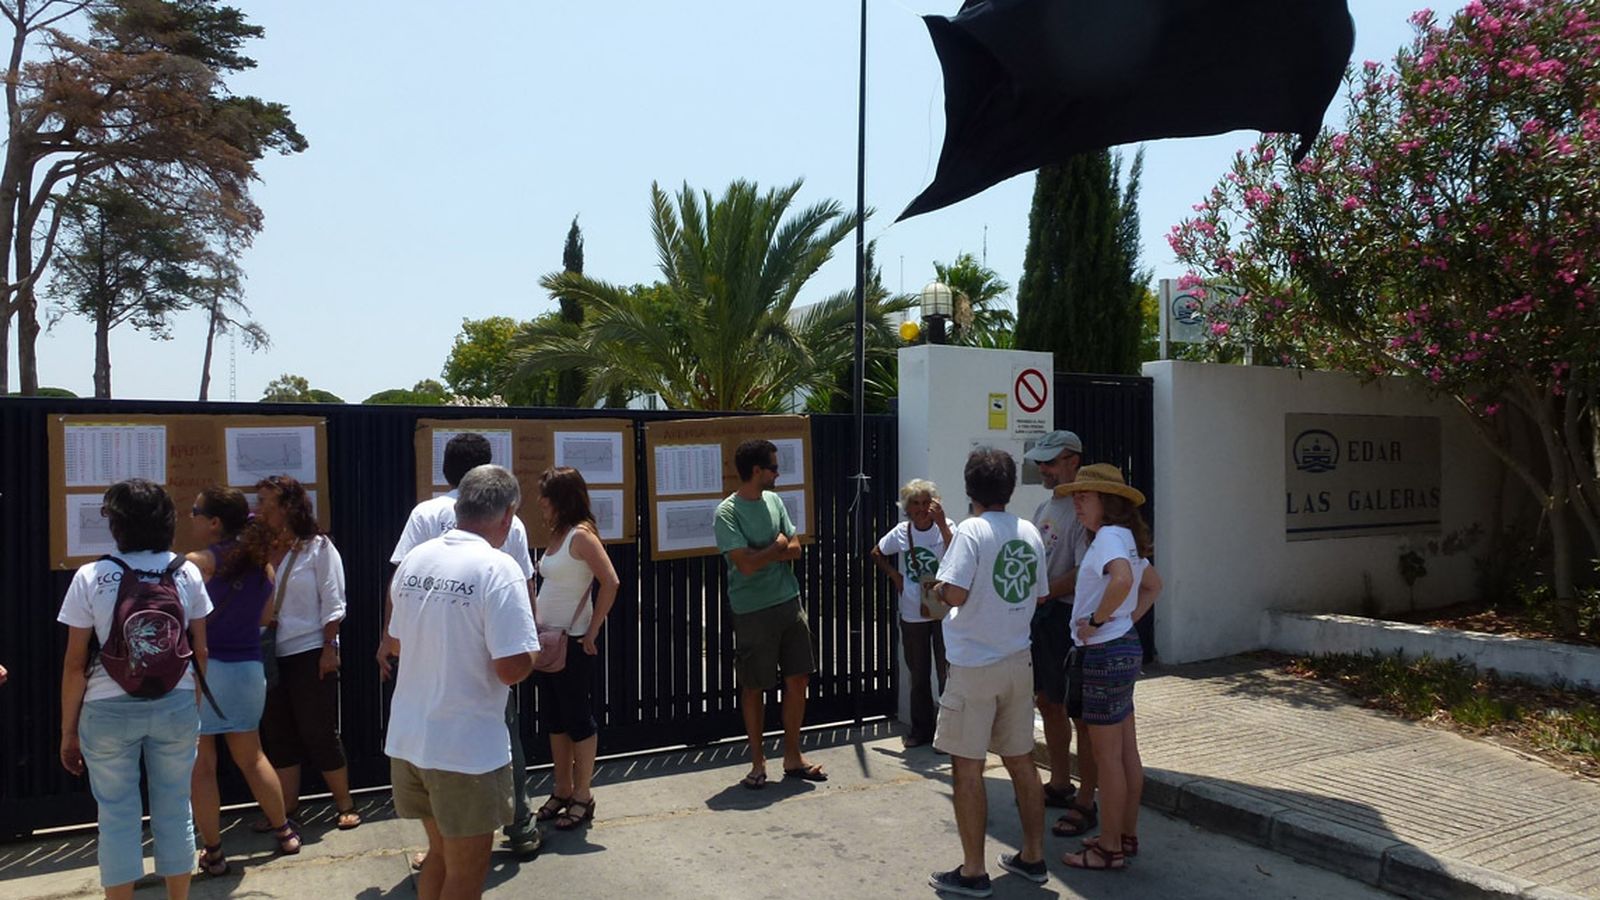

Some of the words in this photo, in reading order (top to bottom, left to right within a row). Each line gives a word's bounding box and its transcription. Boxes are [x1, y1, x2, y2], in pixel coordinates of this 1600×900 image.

[1347, 440, 1402, 462] EDAR
[1286, 491, 1332, 515] LAS
[1348, 487, 1441, 512] GALERAS
